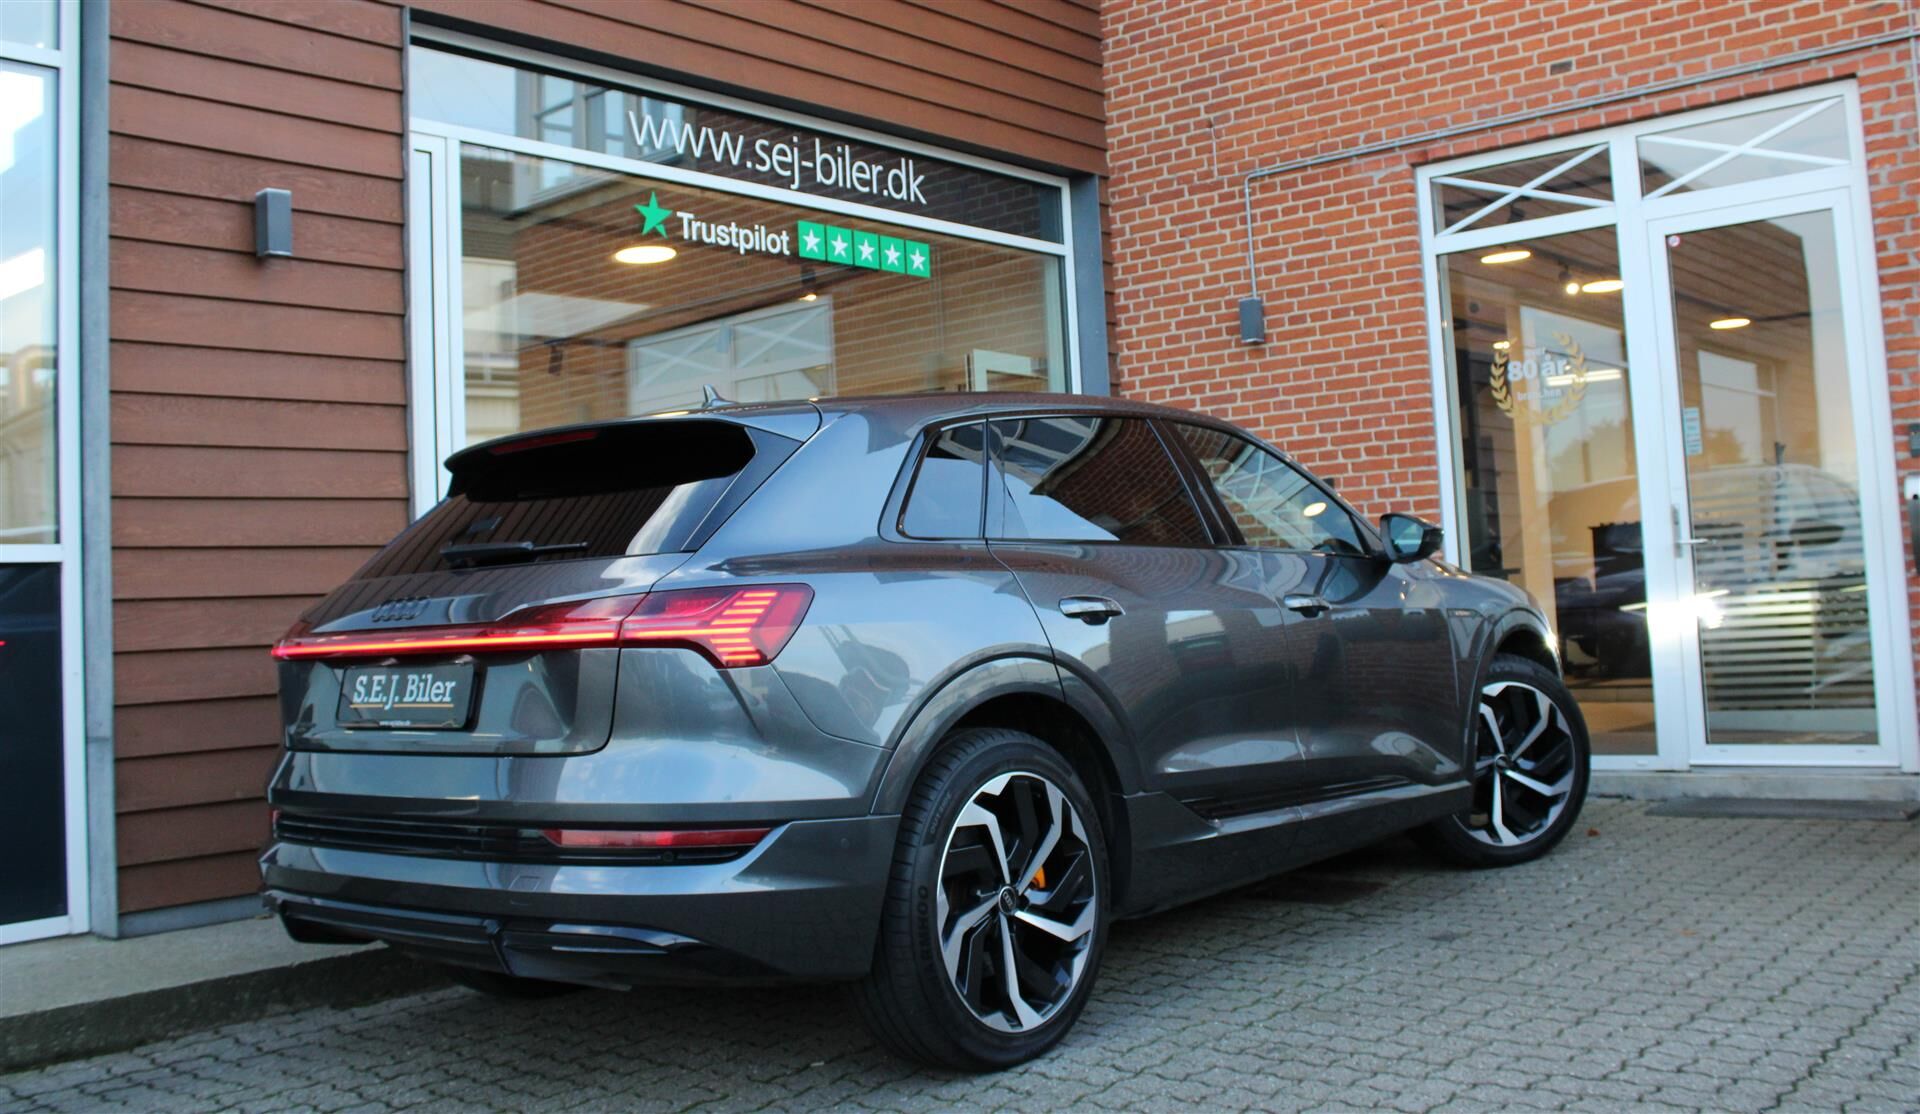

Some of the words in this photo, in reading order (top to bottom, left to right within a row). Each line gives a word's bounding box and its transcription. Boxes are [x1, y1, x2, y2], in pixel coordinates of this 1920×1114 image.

[629, 110, 927, 205] www.sej-biler.dk
[676, 211, 791, 256] Trustpilot
[1507, 360, 1537, 381] 80
[1541, 354, 1567, 377] år
[352, 674, 399, 710] S.E.J.
[403, 674, 457, 703] Biler
